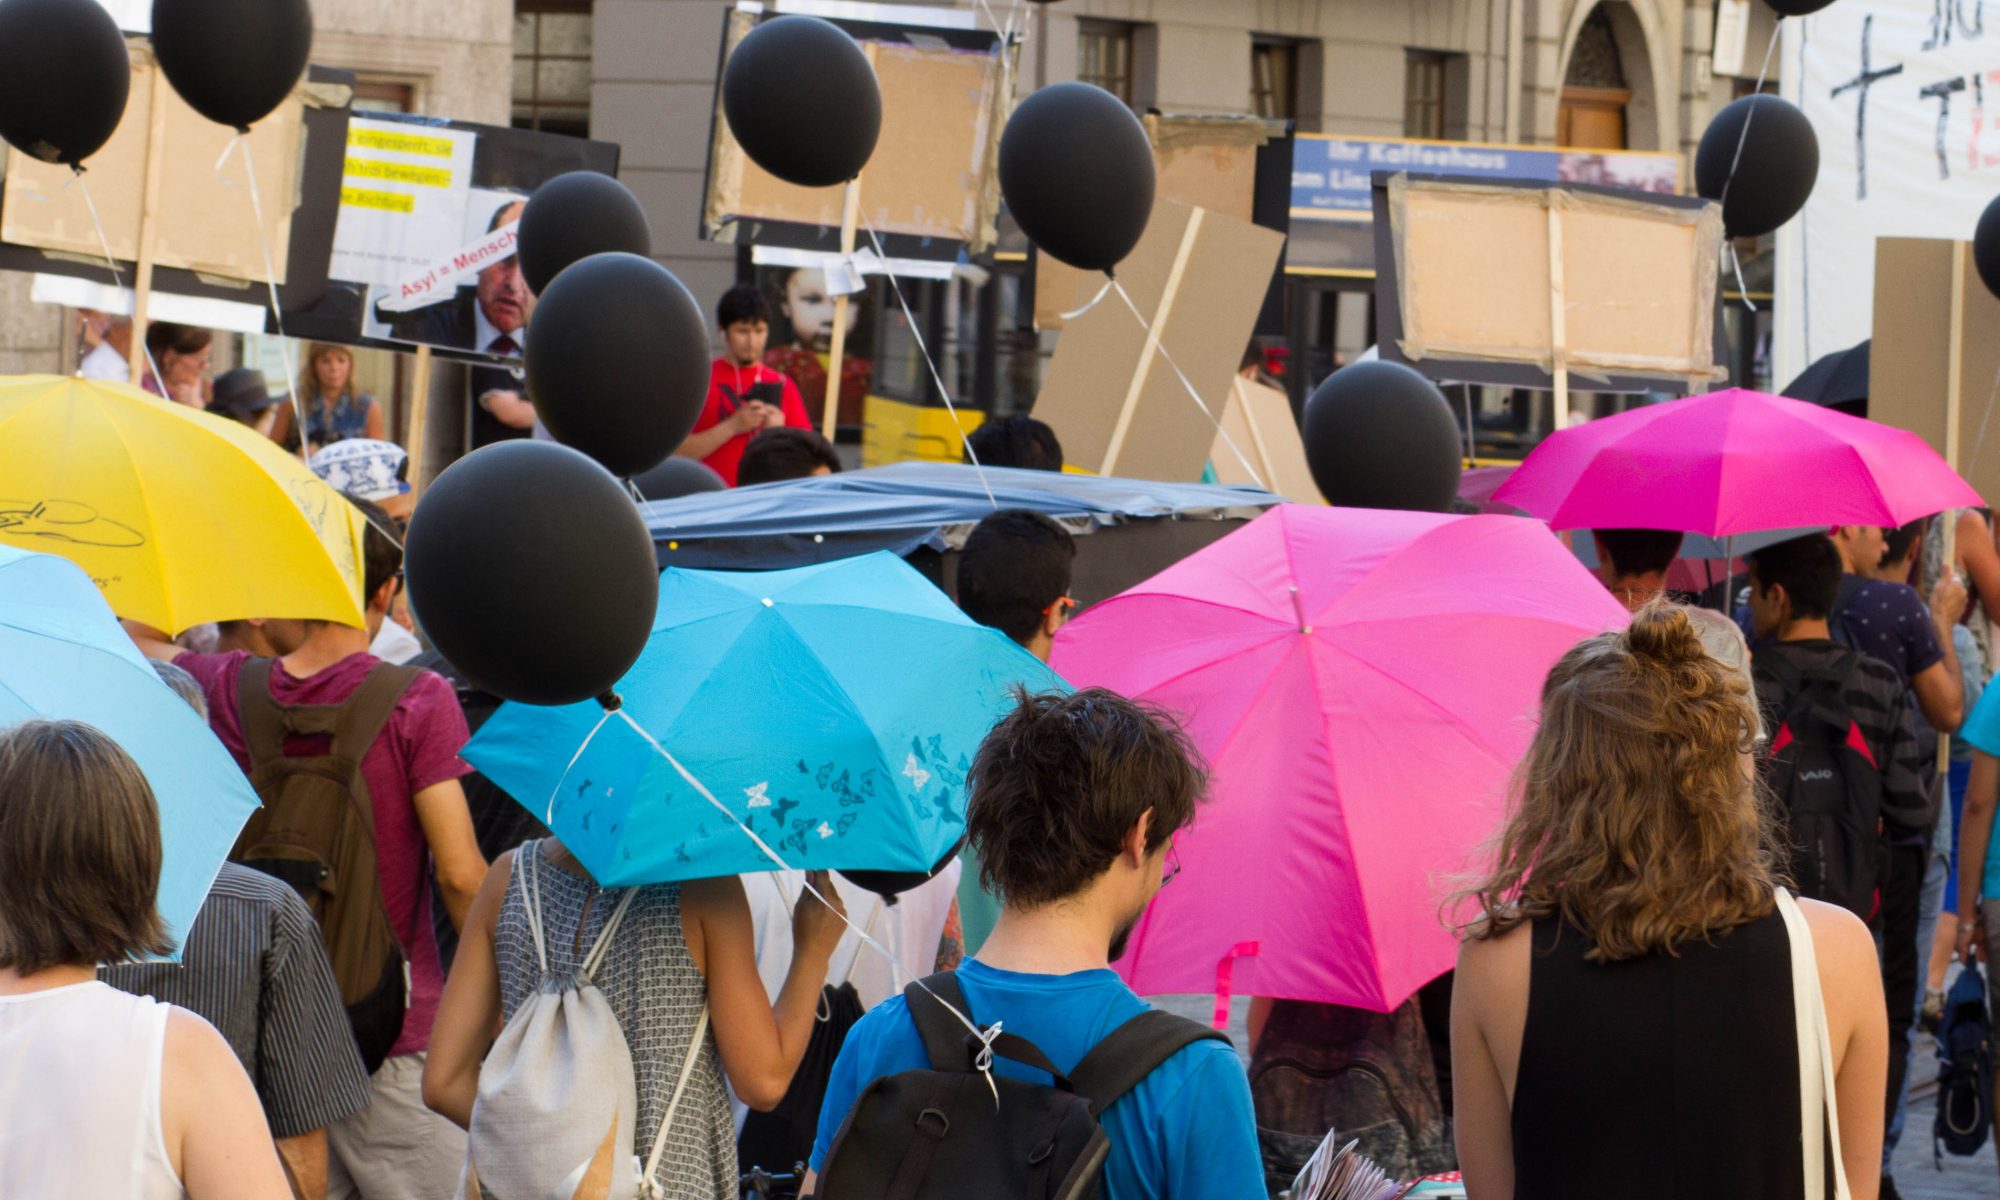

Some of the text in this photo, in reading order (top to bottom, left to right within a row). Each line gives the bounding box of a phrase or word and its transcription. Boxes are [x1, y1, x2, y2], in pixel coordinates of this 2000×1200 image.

[1327, 140, 1507, 169] Ihr Kaffeehaus
[384, 165, 441, 184] bewegen
[401, 271, 437, 298] Asyl
[453, 230, 518, 272] Mensch
